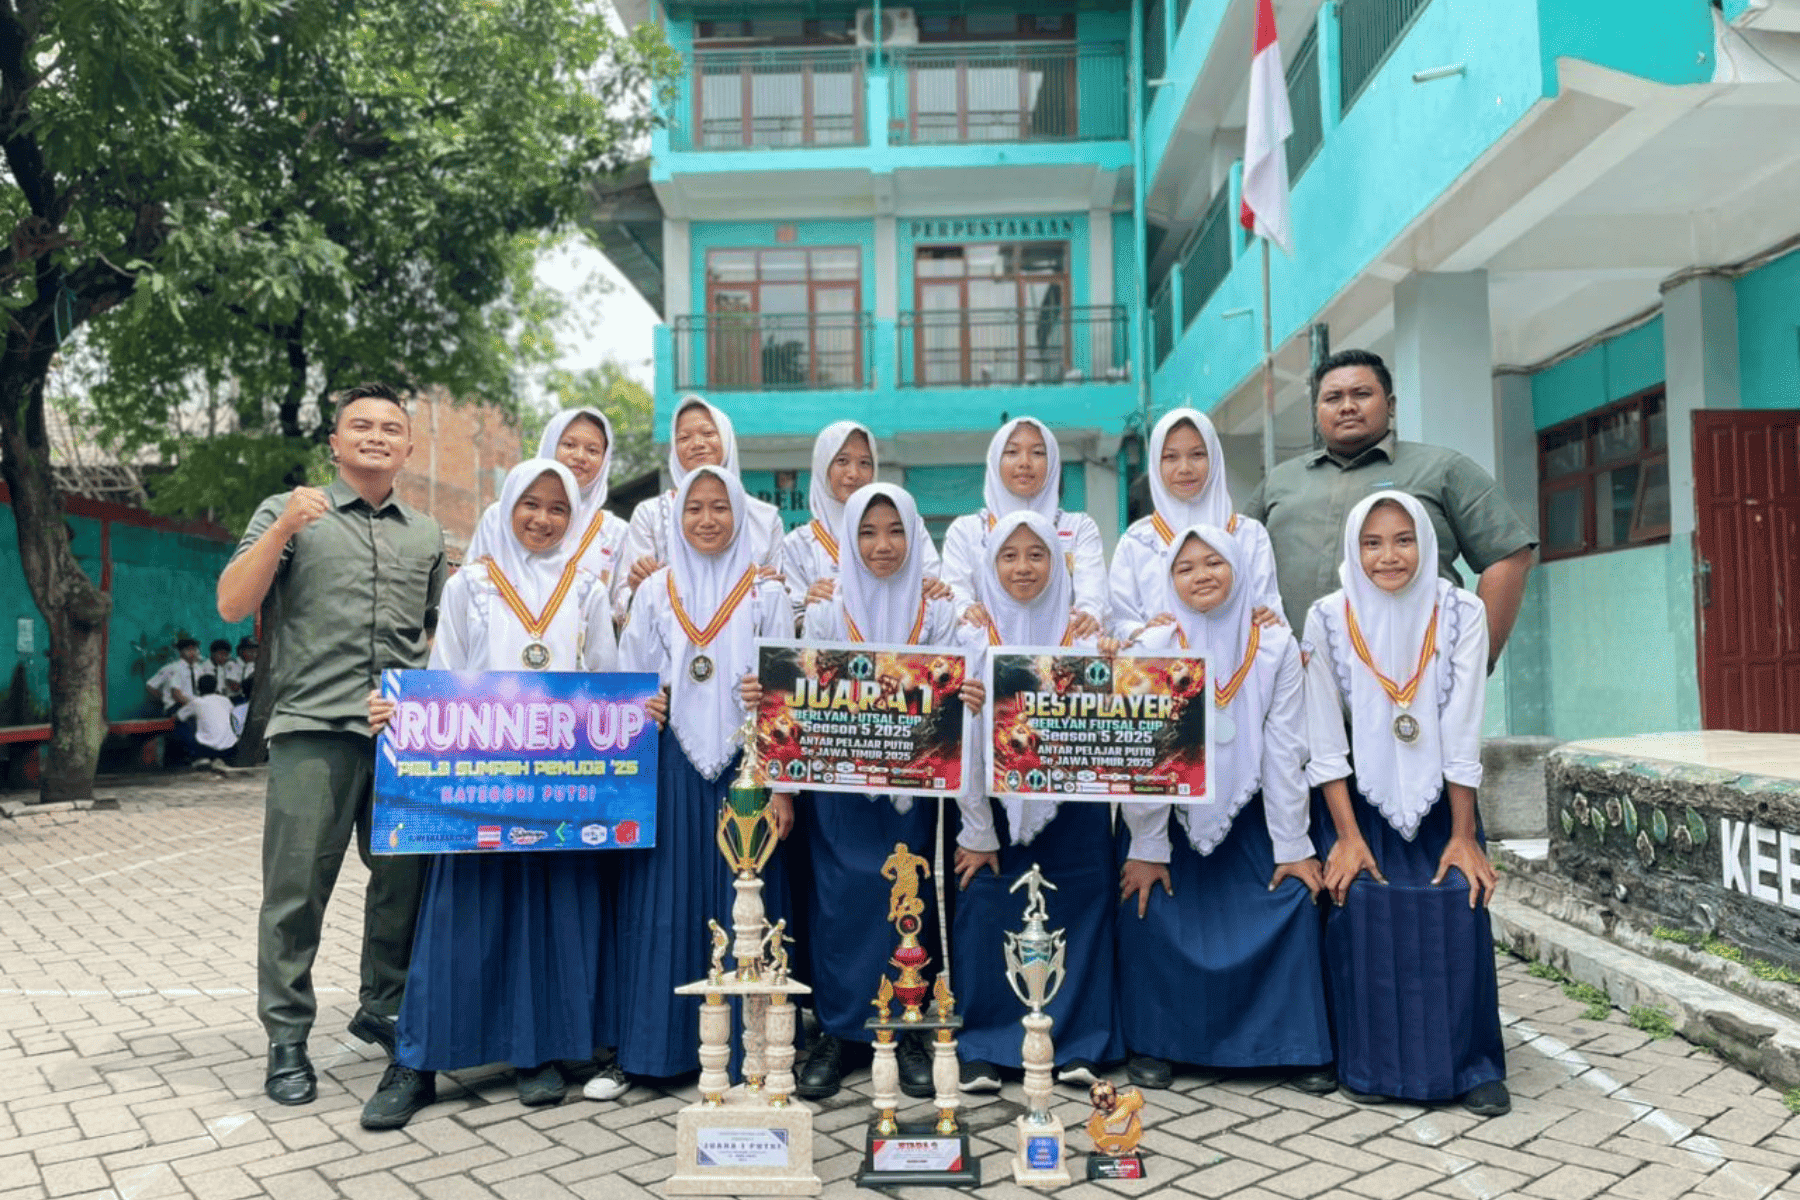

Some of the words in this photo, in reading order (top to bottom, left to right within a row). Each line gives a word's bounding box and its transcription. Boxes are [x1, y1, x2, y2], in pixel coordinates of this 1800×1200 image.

[911, 218, 1073, 237] PERPUSTAKAAN
[784, 677, 908, 713] JUARA
[919, 684, 933, 714] 1
[394, 701, 576, 750] RUNNER
[587, 702, 645, 750] UP
[795, 709, 848, 723] BERLYAN
[851, 711, 895, 725] FUTSAL
[898, 714, 922, 727] CUP
[1030, 717, 1087, 730] BERLYAN
[1090, 718, 1134, 731] FUTSAL
[1138, 720, 1163, 731] CUP
[803, 721, 857, 735] Season
[861, 723, 873, 736] 5
[875, 724, 912, 738] 2025
[1041, 729, 1097, 743] Season
[1101, 731, 1111, 743] 5
[1115, 731, 1153, 744] 2025
[800, 735, 833, 747] ANTAR
[836, 738, 881, 750] PELAJAR
[884, 740, 914, 751] PUTRI
[1038, 744, 1073, 755] ANTAR
[1075, 745, 1122, 756] PELAJAR
[1125, 746, 1155, 757] PUTRI
[816, 747, 848, 758] JAWA
[851, 749, 882, 760] TIMUR
[885, 751, 911, 761] 2025
[1055, 756, 1088, 766] JAWA
[1091, 756, 1124, 767] TIMUR
[1127, 757, 1154, 768] 2025
[441, 784, 535, 803] KATEGORI
[542, 784, 597, 802] PUTRI
[1721, 818, 1800, 910] KEE
